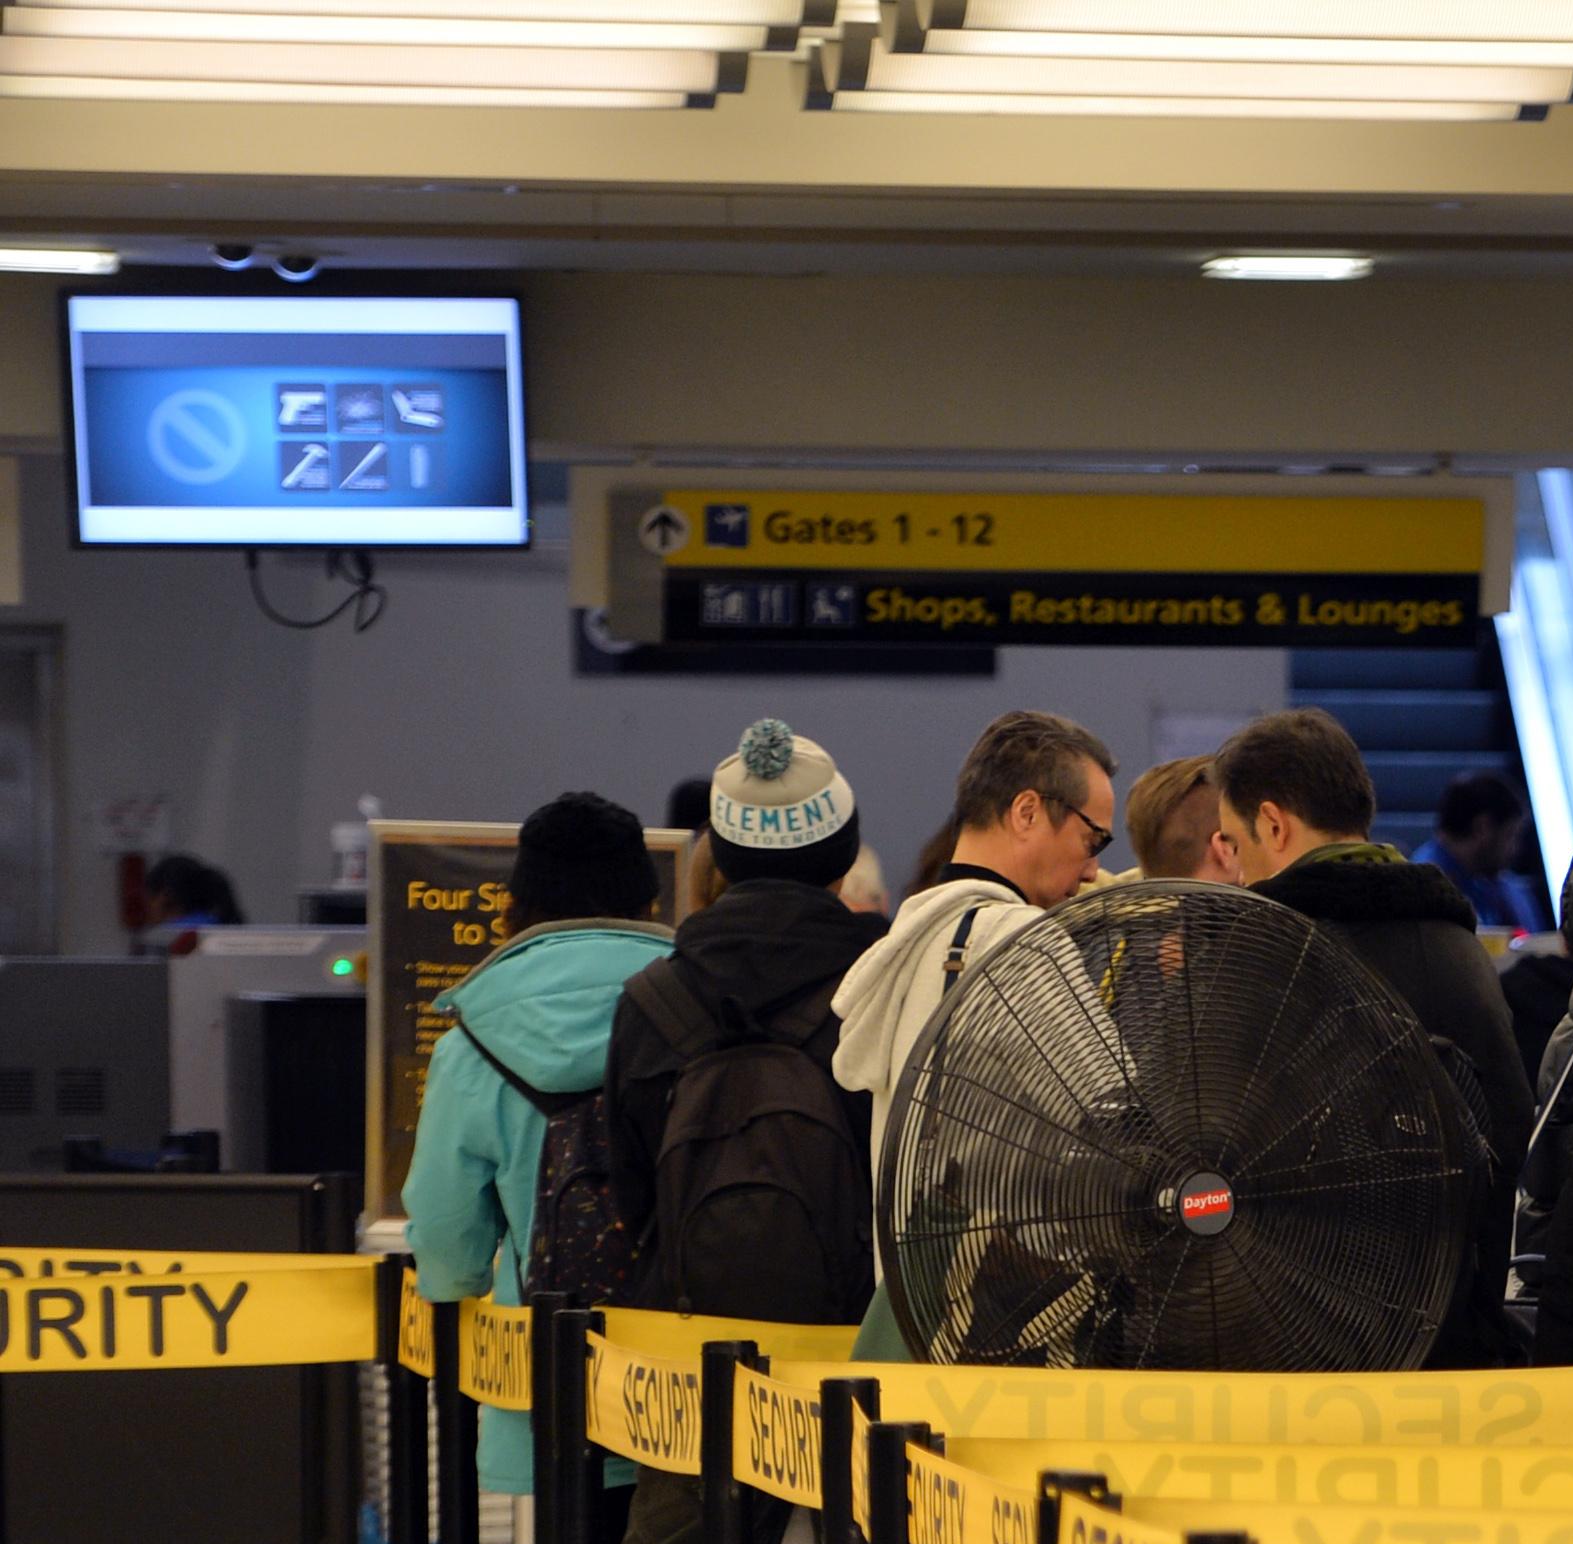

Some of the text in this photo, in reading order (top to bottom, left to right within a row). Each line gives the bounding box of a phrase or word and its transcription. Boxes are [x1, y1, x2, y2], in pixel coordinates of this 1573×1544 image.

[764, 509, 877, 546] Gates
[893, 513, 911, 544] 1
[952, 512, 995, 546] 12
[865, 587, 1463, 633] Shops, Restaurants & Lounges
[715, 789, 836, 833] ELEMENT
[407, 880, 473, 912] Four
[452, 920, 486, 946] to
[1184, 1193, 1228, 1210] Dayton
